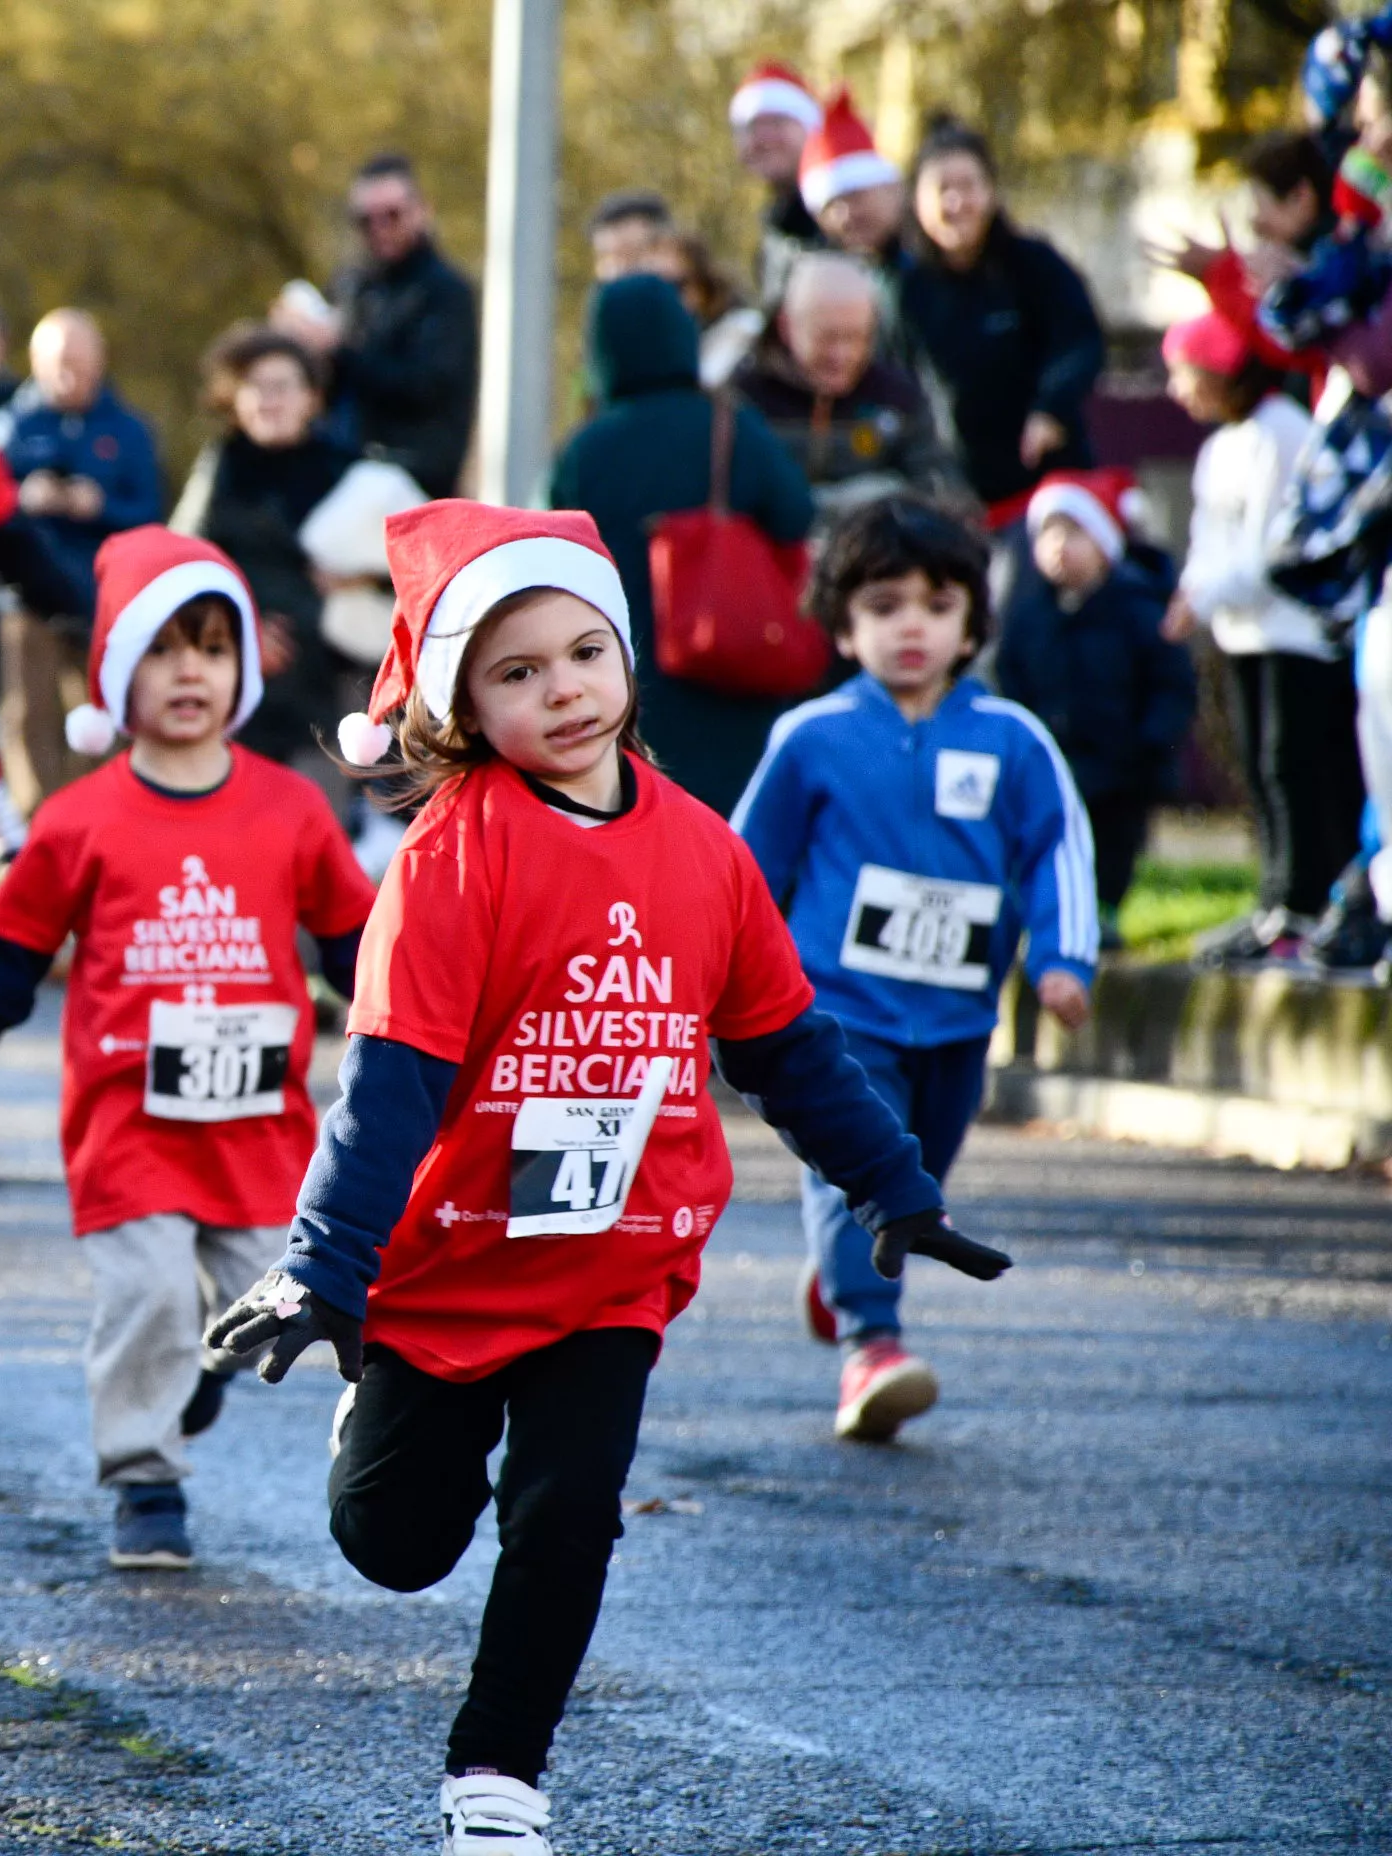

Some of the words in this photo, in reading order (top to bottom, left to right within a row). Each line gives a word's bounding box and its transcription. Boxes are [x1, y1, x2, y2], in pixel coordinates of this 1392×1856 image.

[158, 885, 236, 918] SAN
[133, 917, 260, 945] SILVESTRE
[877, 904, 971, 966] 409
[124, 943, 269, 972] BERCIANA
[563, 953, 673, 1004] SAN
[513, 1010, 700, 1050] SILVESTRE
[178, 1043, 262, 1100] 301
[566, 1106, 595, 1117] SAN
